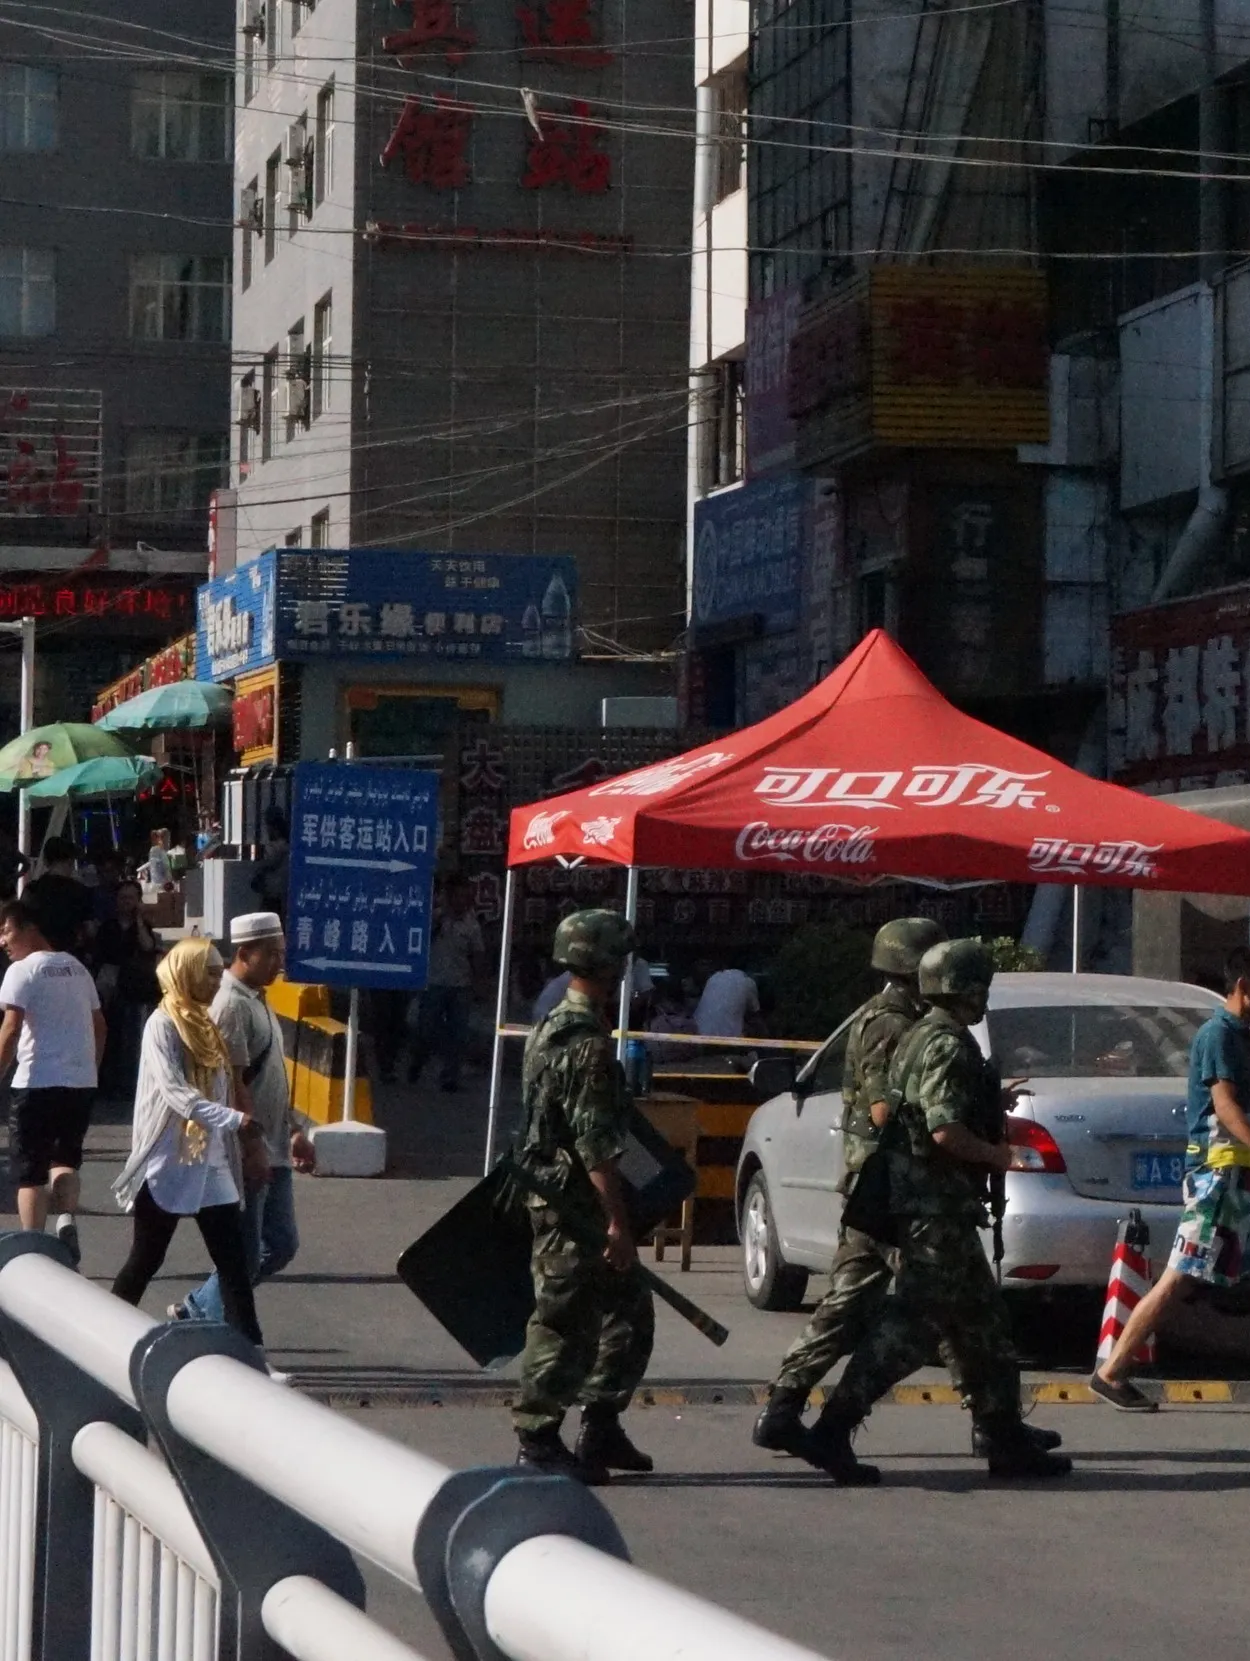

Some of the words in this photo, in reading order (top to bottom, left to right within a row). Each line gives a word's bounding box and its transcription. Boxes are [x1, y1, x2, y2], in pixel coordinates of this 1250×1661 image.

[753, 763, 1052, 811] 可口可乐
[301, 814, 428, 853] 军供客运站入口
[735, 822, 878, 864] Coca-Cola
[1028, 838, 1164, 877] 可口可乐
[296, 916, 423, 954] 青峰路入口
